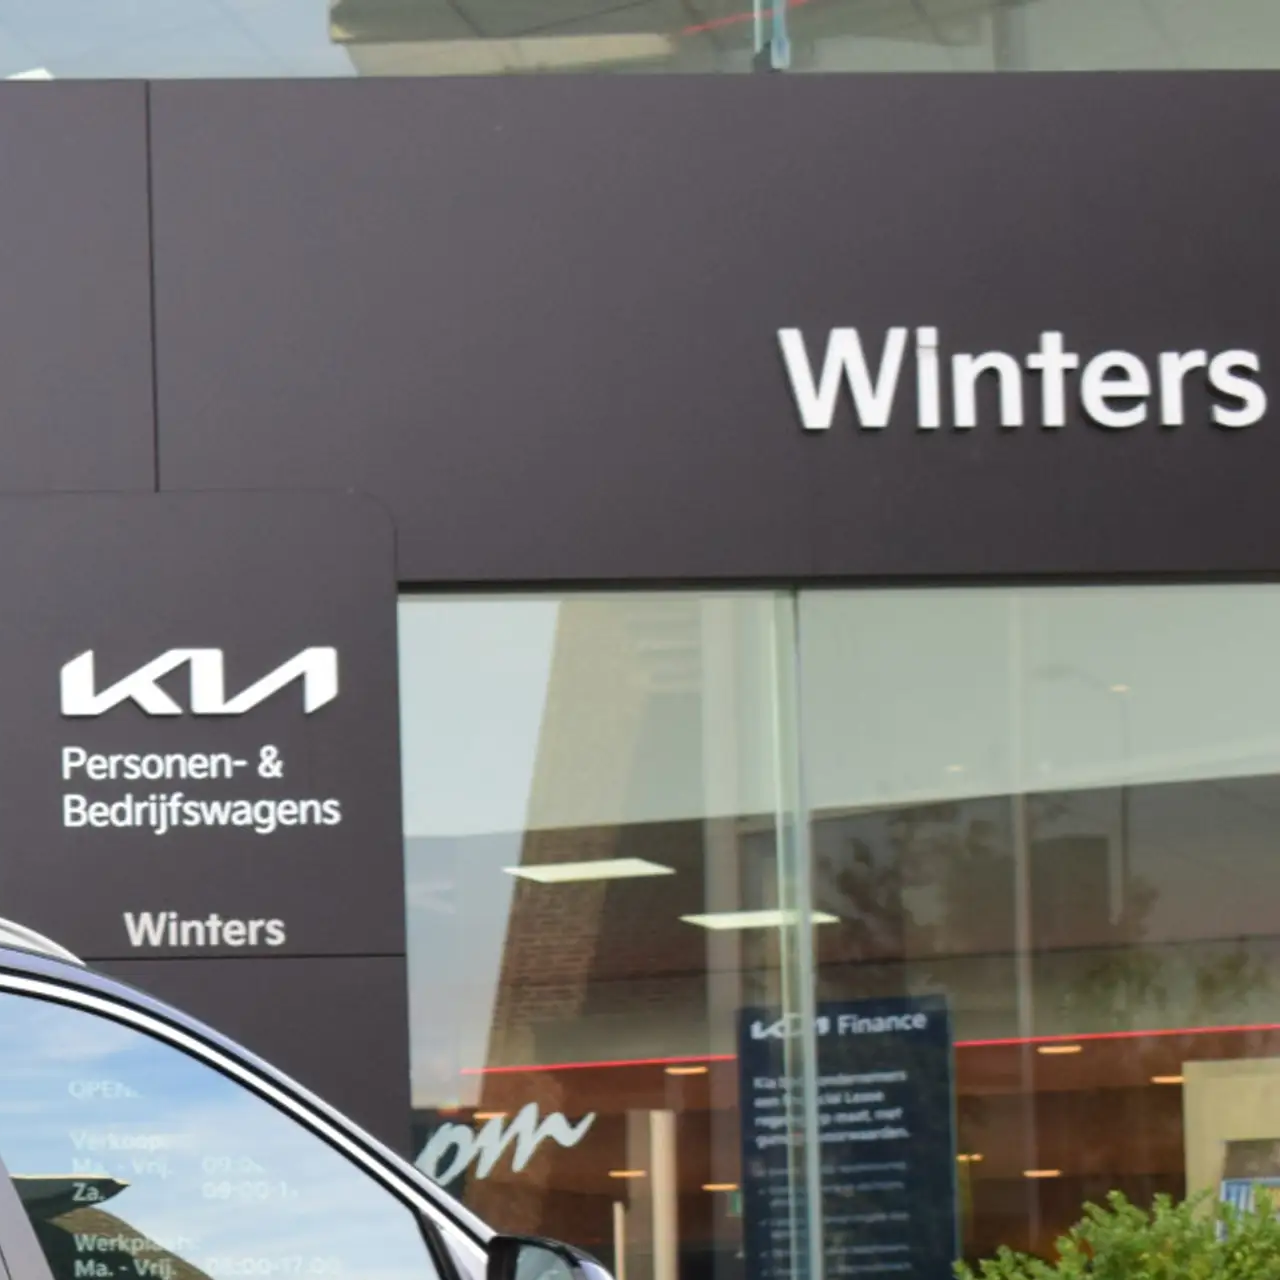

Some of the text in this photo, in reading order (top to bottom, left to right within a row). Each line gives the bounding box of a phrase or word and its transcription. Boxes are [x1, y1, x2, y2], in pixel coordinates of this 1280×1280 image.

[777, 325, 1268, 430] Winters
[60, 646, 339, 715] KIA
[61, 744, 284, 780] Personen- &
[62, 793, 342, 834] Bedrijfswagens
[124, 911, 287, 948] Winters
[837, 1012, 928, 1036] Finance
[72, 1181, 108, 1201] Za.
[73, 1258, 114, 1279] Ma.
[133, 1258, 178, 1280] Vrij.
